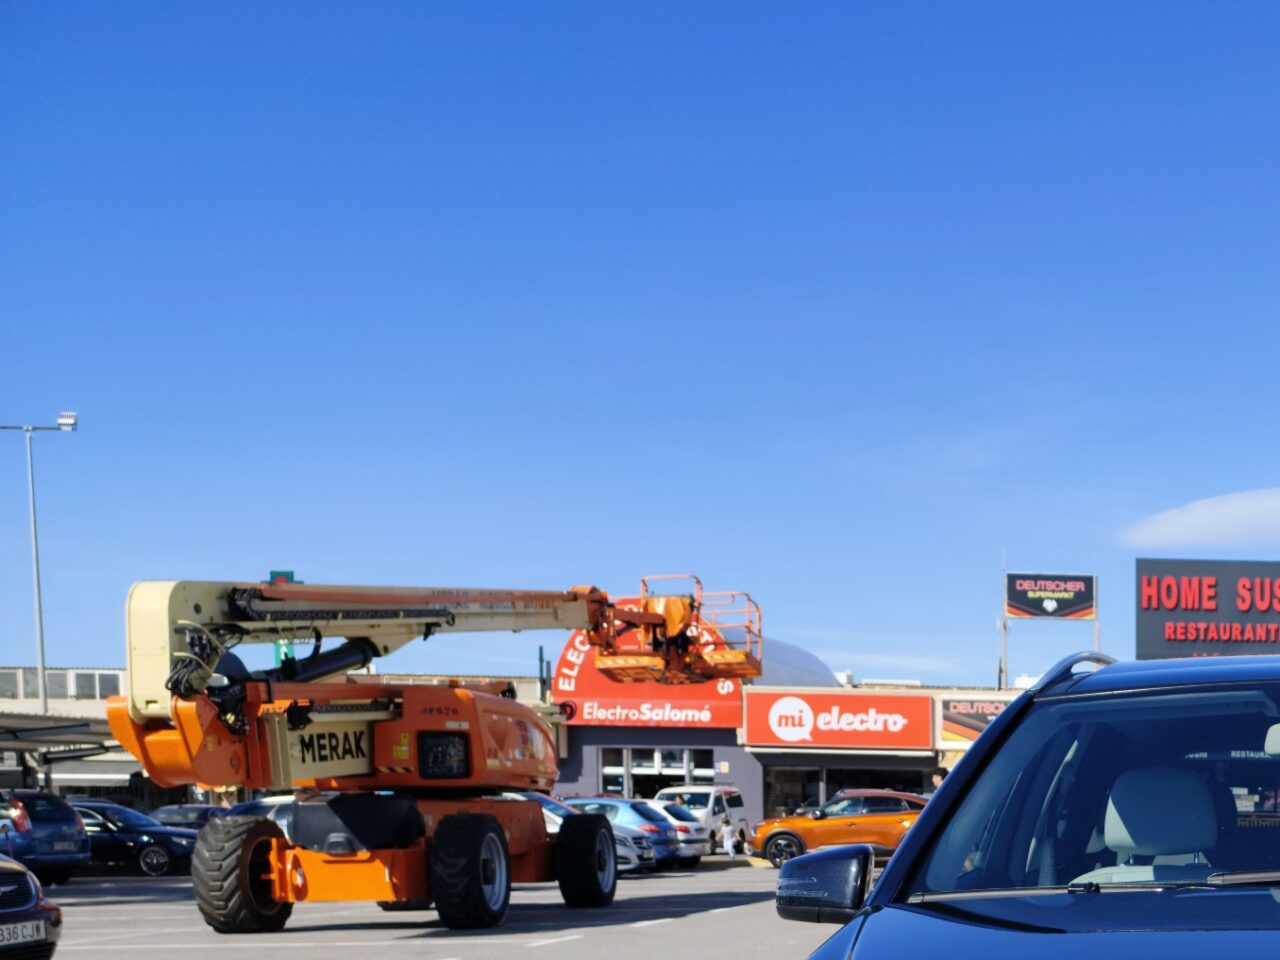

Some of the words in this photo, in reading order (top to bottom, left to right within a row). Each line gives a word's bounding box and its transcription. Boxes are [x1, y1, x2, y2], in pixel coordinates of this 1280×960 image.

[1015, 579, 1085, 592] DEUTSCHER
[1141, 575, 1217, 611] HOME
[582, 702, 712, 723] ElectroSalomé
[777, 708, 806, 728] mi
[816, 705, 908, 733] electro
[949, 701, 1005, 715] DEUTSC
[300, 730, 367, 764] MERAK
